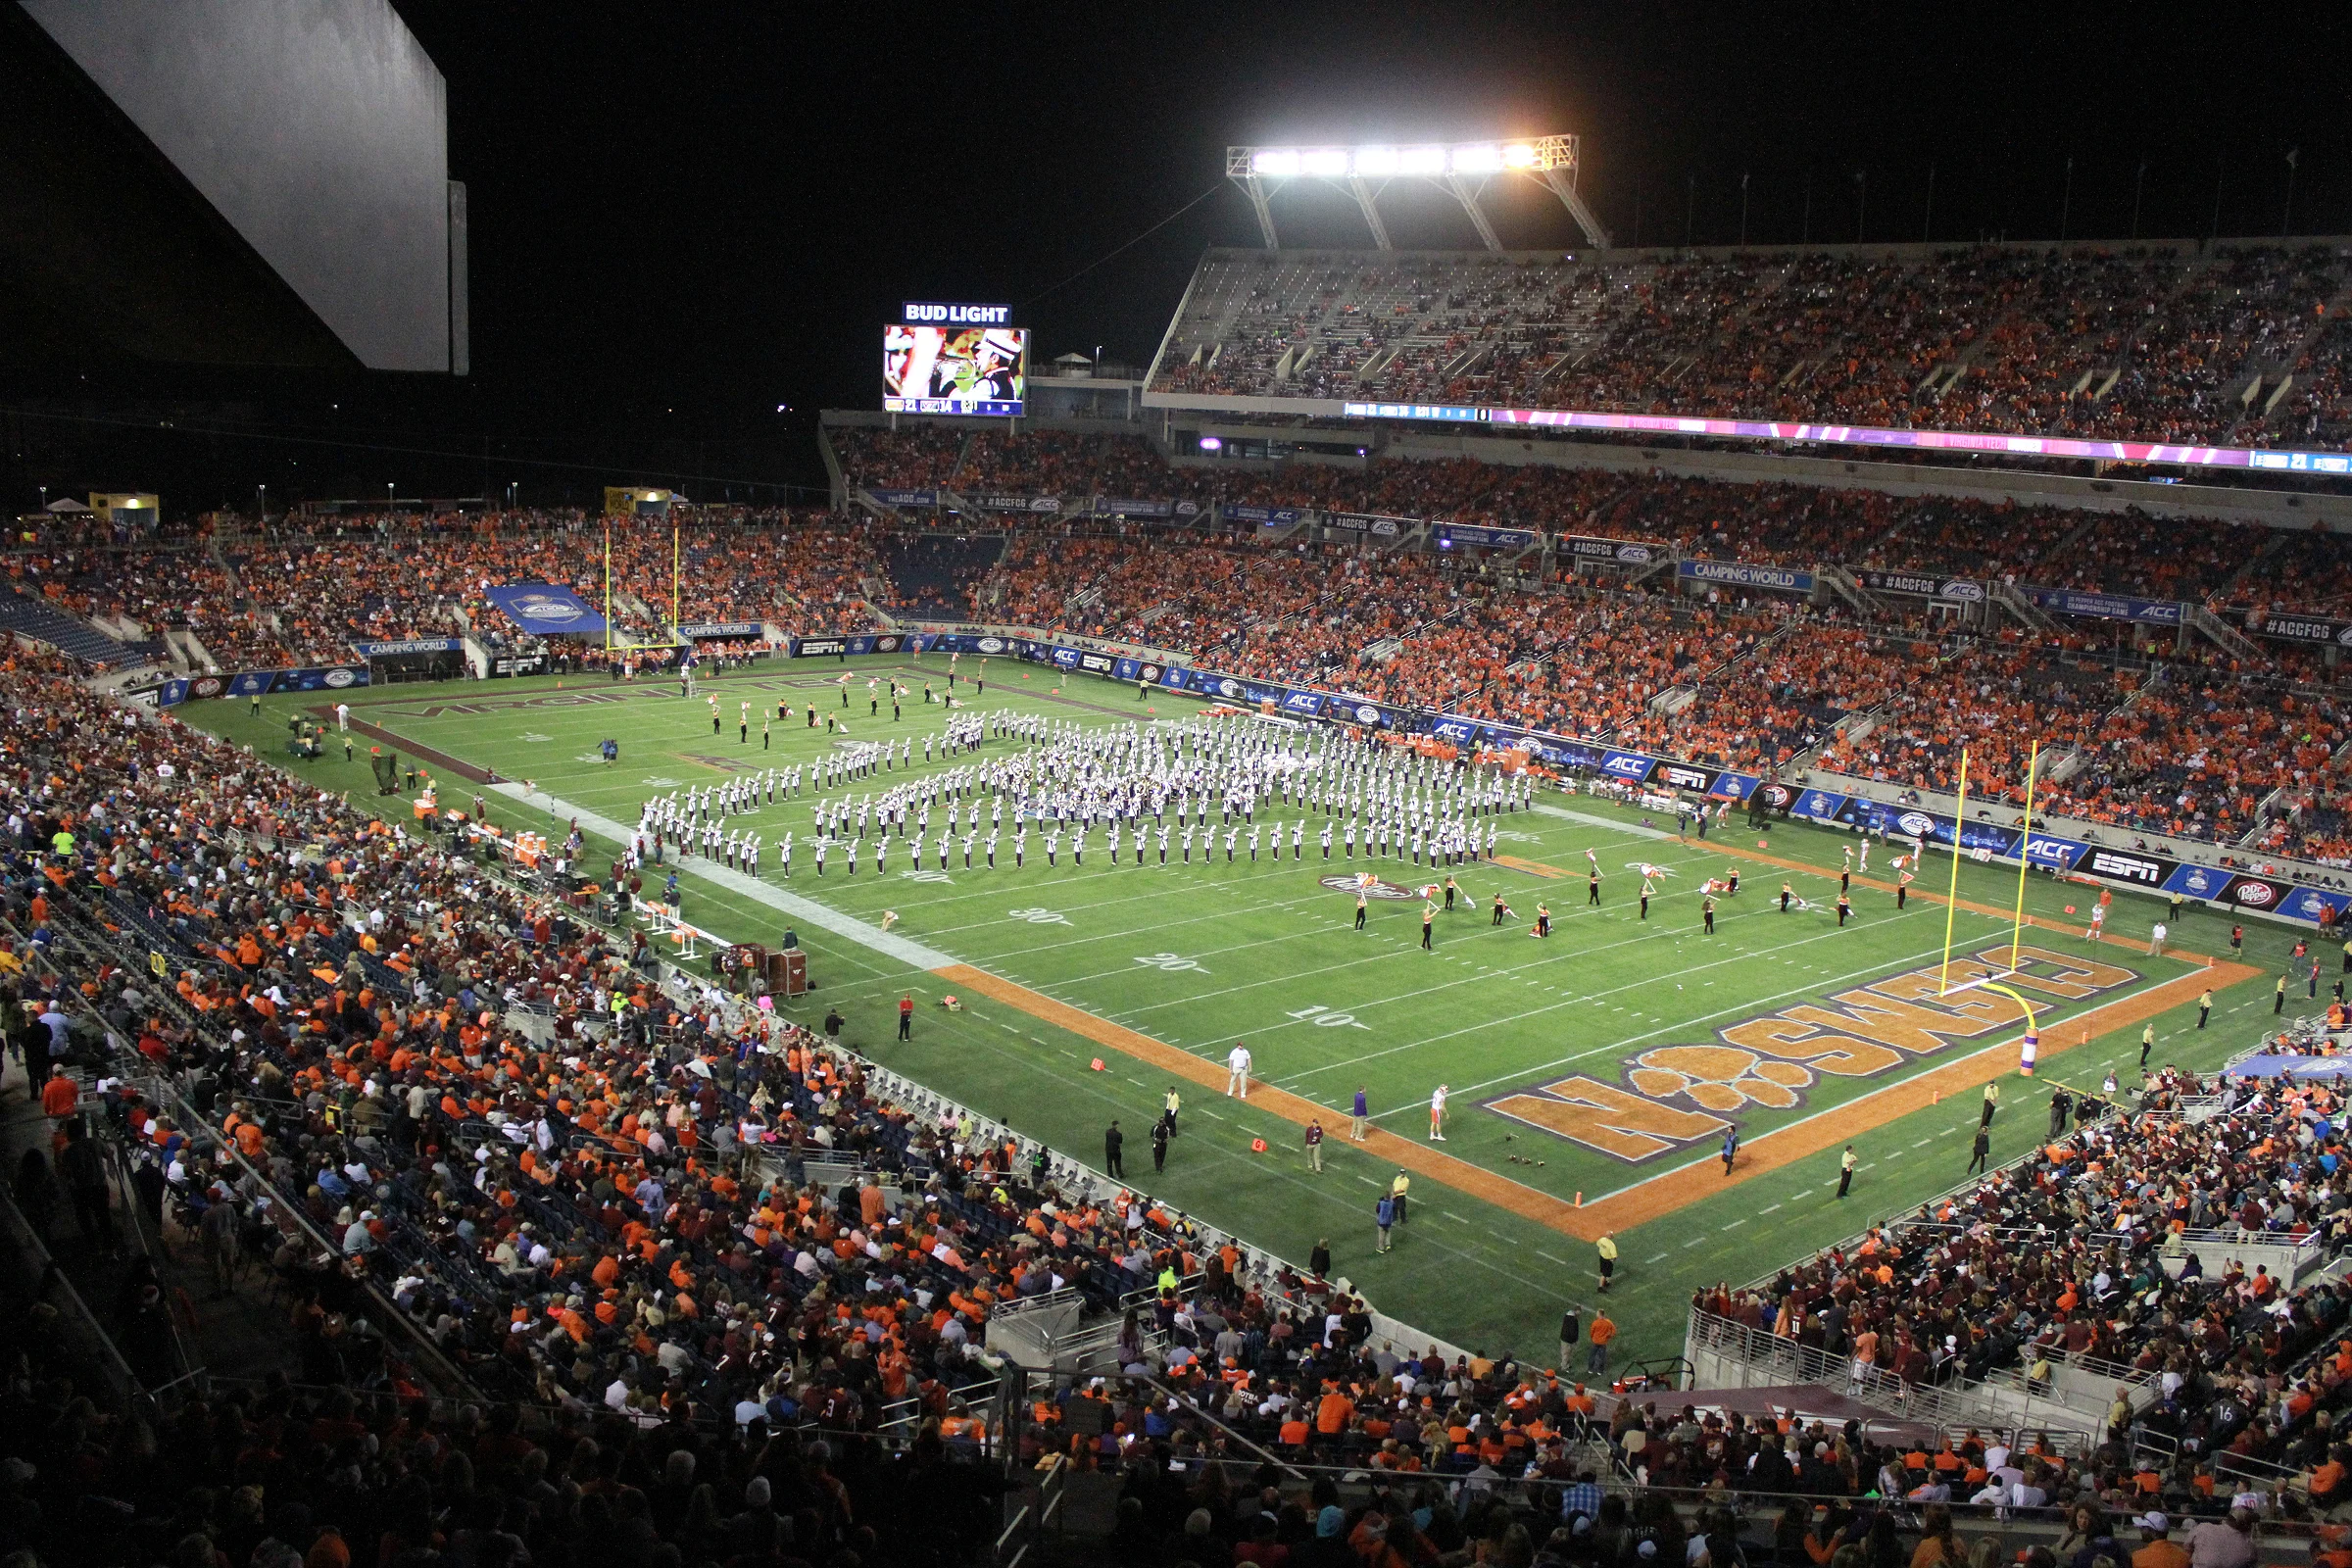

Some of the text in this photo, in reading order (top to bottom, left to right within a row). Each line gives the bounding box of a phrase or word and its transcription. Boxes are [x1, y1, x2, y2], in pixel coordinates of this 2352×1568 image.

[906, 304, 1008, 323] BUD LIGHT
[906, 399, 917, 412] 21
[1950, 433, 1984, 449] VIRGINIA
[1986, 437, 2007, 451] TECH
[988, 495, 1026, 508] #ACCFCG
[1274, 511, 1293, 519] ACC
[1337, 516, 1367, 530] #ACCFCG
[1495, 534, 1518, 544] ACC
[1574, 542, 1612, 556] #ACCFCG
[1694, 564, 1795, 587] CAMPING WORLD
[1886, 578, 1936, 593] #ACCFCG
[2138, 606, 2177, 618] ACC
[685, 624, 751, 636] CAMPING WORLD
[2266, 618, 2329, 639] #ACCFCG
[369, 640, 448, 655] CAMPING WORLD
[802, 641, 839, 655] ESPN
[1054, 649, 1076, 662] ACC
[1287, 694, 1318, 709] ACC
[1434, 722, 1469, 738] ACC
[1605, 756, 1645, 773] ACC
[2022, 839, 2076, 860] ACC
[2092, 852, 2160, 882] ESPN
[2241, 885, 2269, 902] Pepper
[2250, 883, 2263, 894] Dr
[1008, 906, 1064, 924] 30
[745, 953, 754, 963] G
[1134, 953, 1198, 971] 20
[1286, 1004, 1356, 1028] 10
[769, 1307, 778, 1323] 7
[1791, 1320, 1800, 1335] 11
[715, 1353, 731, 1371] 7
[826, 1398, 835, 1418] 3
[2219, 1404, 2233, 1422] 16
